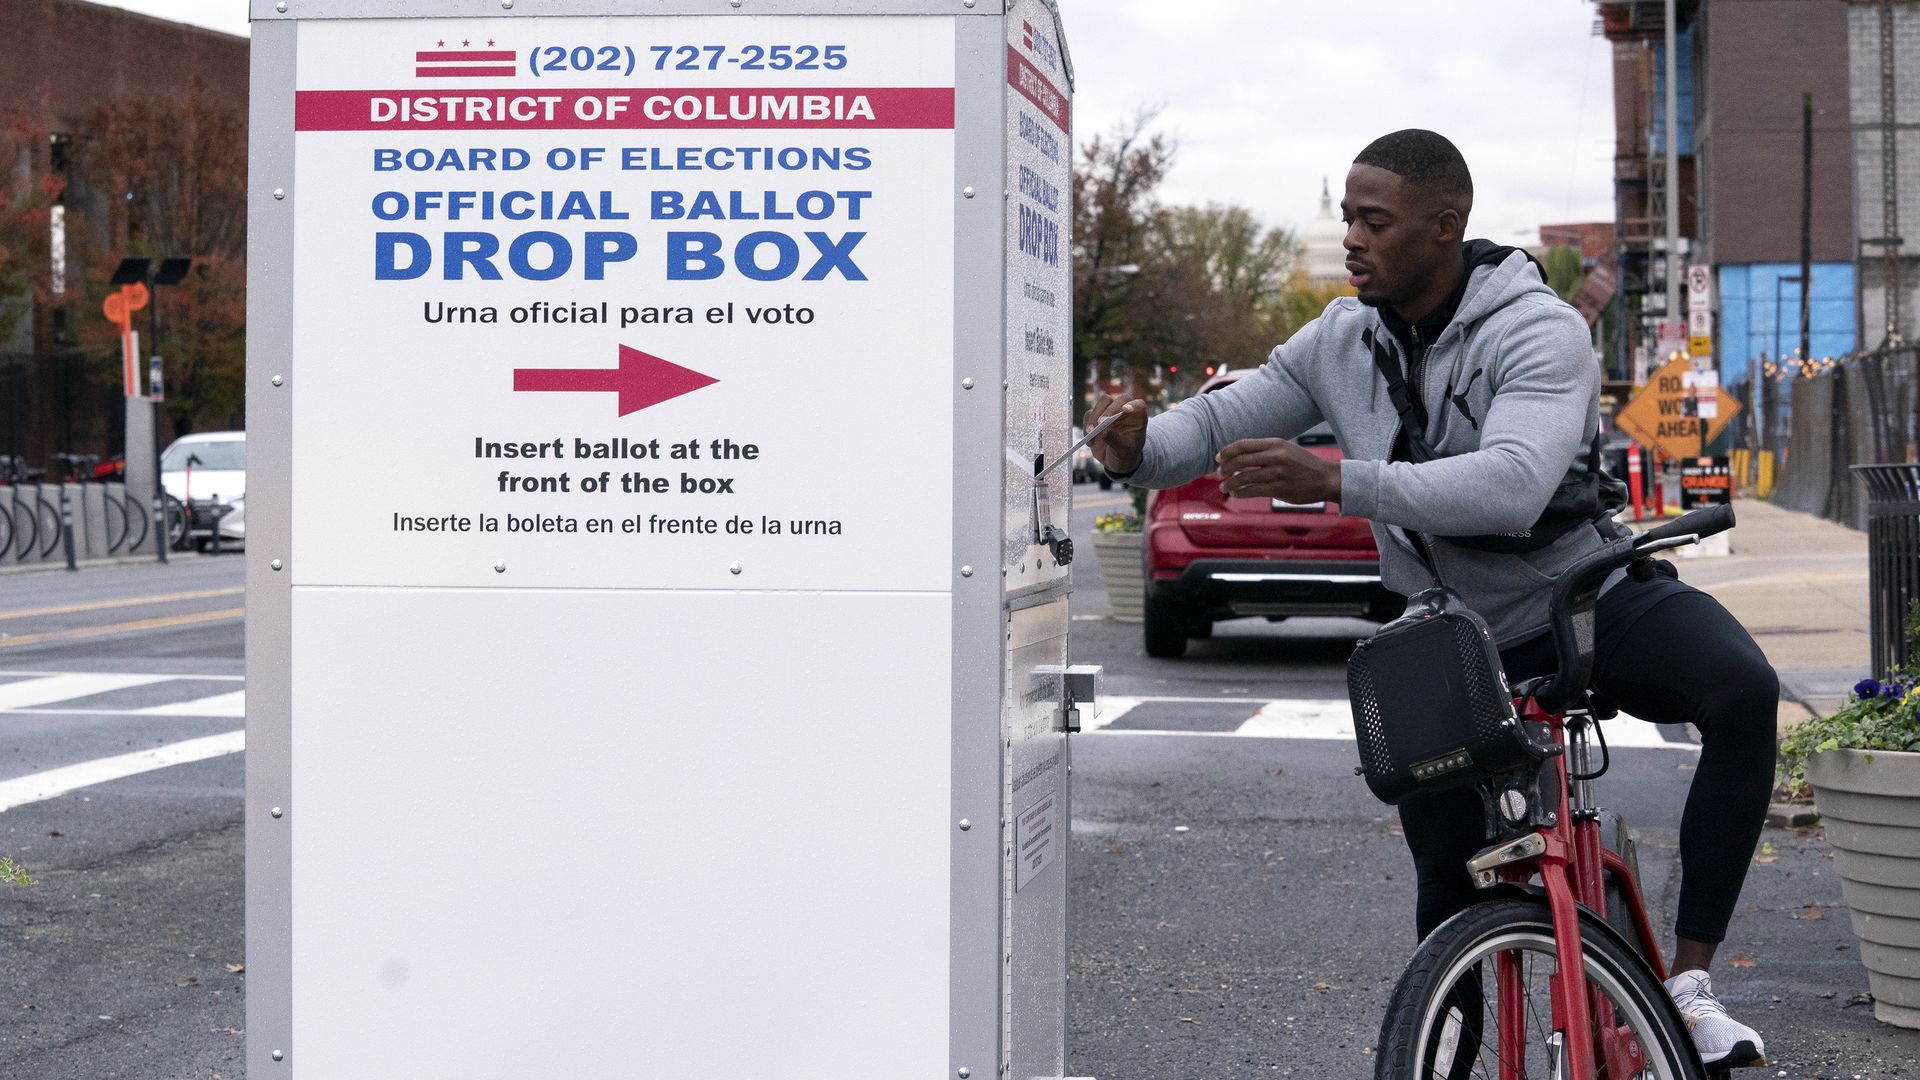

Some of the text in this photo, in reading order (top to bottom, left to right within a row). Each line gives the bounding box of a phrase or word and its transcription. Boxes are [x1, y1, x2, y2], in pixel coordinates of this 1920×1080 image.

[529, 44, 848, 77] (202) 727-2525
[370, 95, 876, 122] DISTRICT OF COLUMBIA
[374, 147, 872, 172] BOARD OF ELECTIONS
[372, 190, 873, 221] OFFICIAL BALLOT
[1019, 202, 1059, 268] DROP BOX
[375, 231, 869, 282] DROP BOX
[424, 302, 815, 329] Urna oficial para el voto
[1659, 375, 1683, 393] RO
[1658, 398, 1682, 416] WO
[475, 437, 760, 460] Insert ballot at the
[497, 471, 735, 494] front of the box
[393, 512, 842, 536] Inserte la boleta en el frente de la urna
